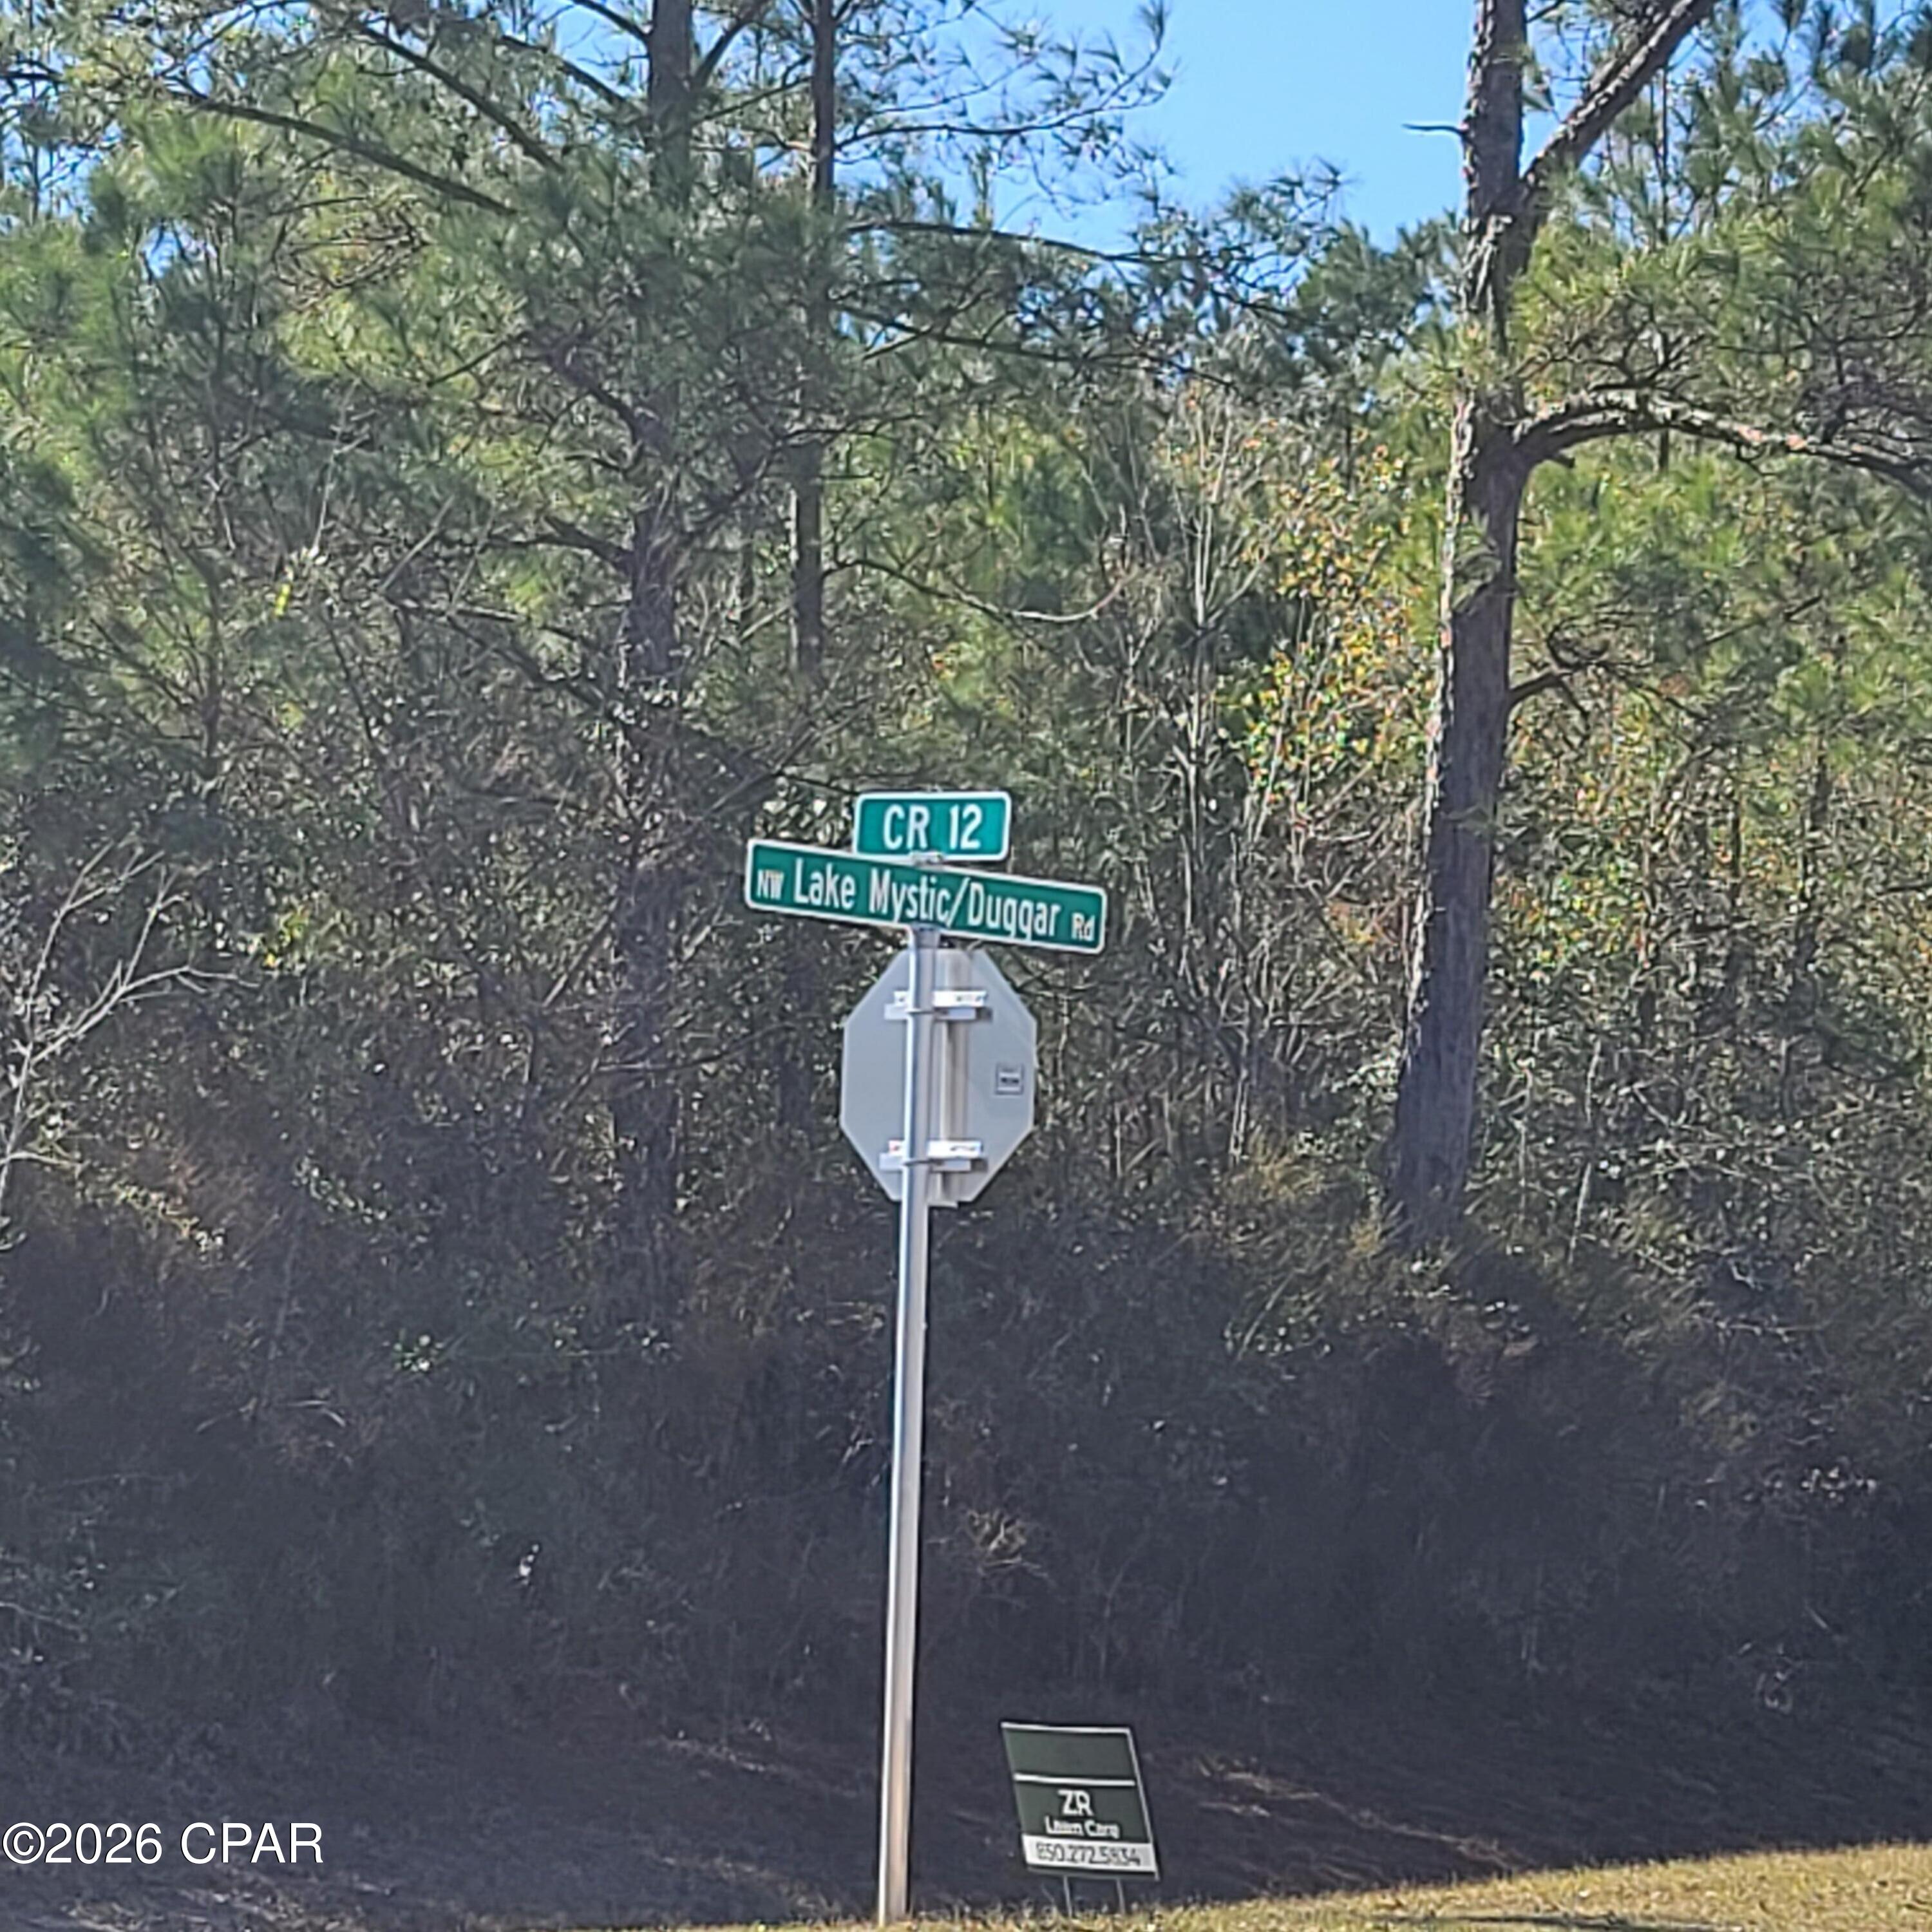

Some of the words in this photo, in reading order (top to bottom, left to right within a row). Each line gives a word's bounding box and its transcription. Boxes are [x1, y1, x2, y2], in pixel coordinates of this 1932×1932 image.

[883, 804, 929, 849] CR
[949, 805, 983, 849] 12
[757, 869, 784, 900] NW
[794, 858, 856, 908] Lake
[1071, 913, 1095, 942] Rd
[1057, 1789, 1093, 1816] ZR
